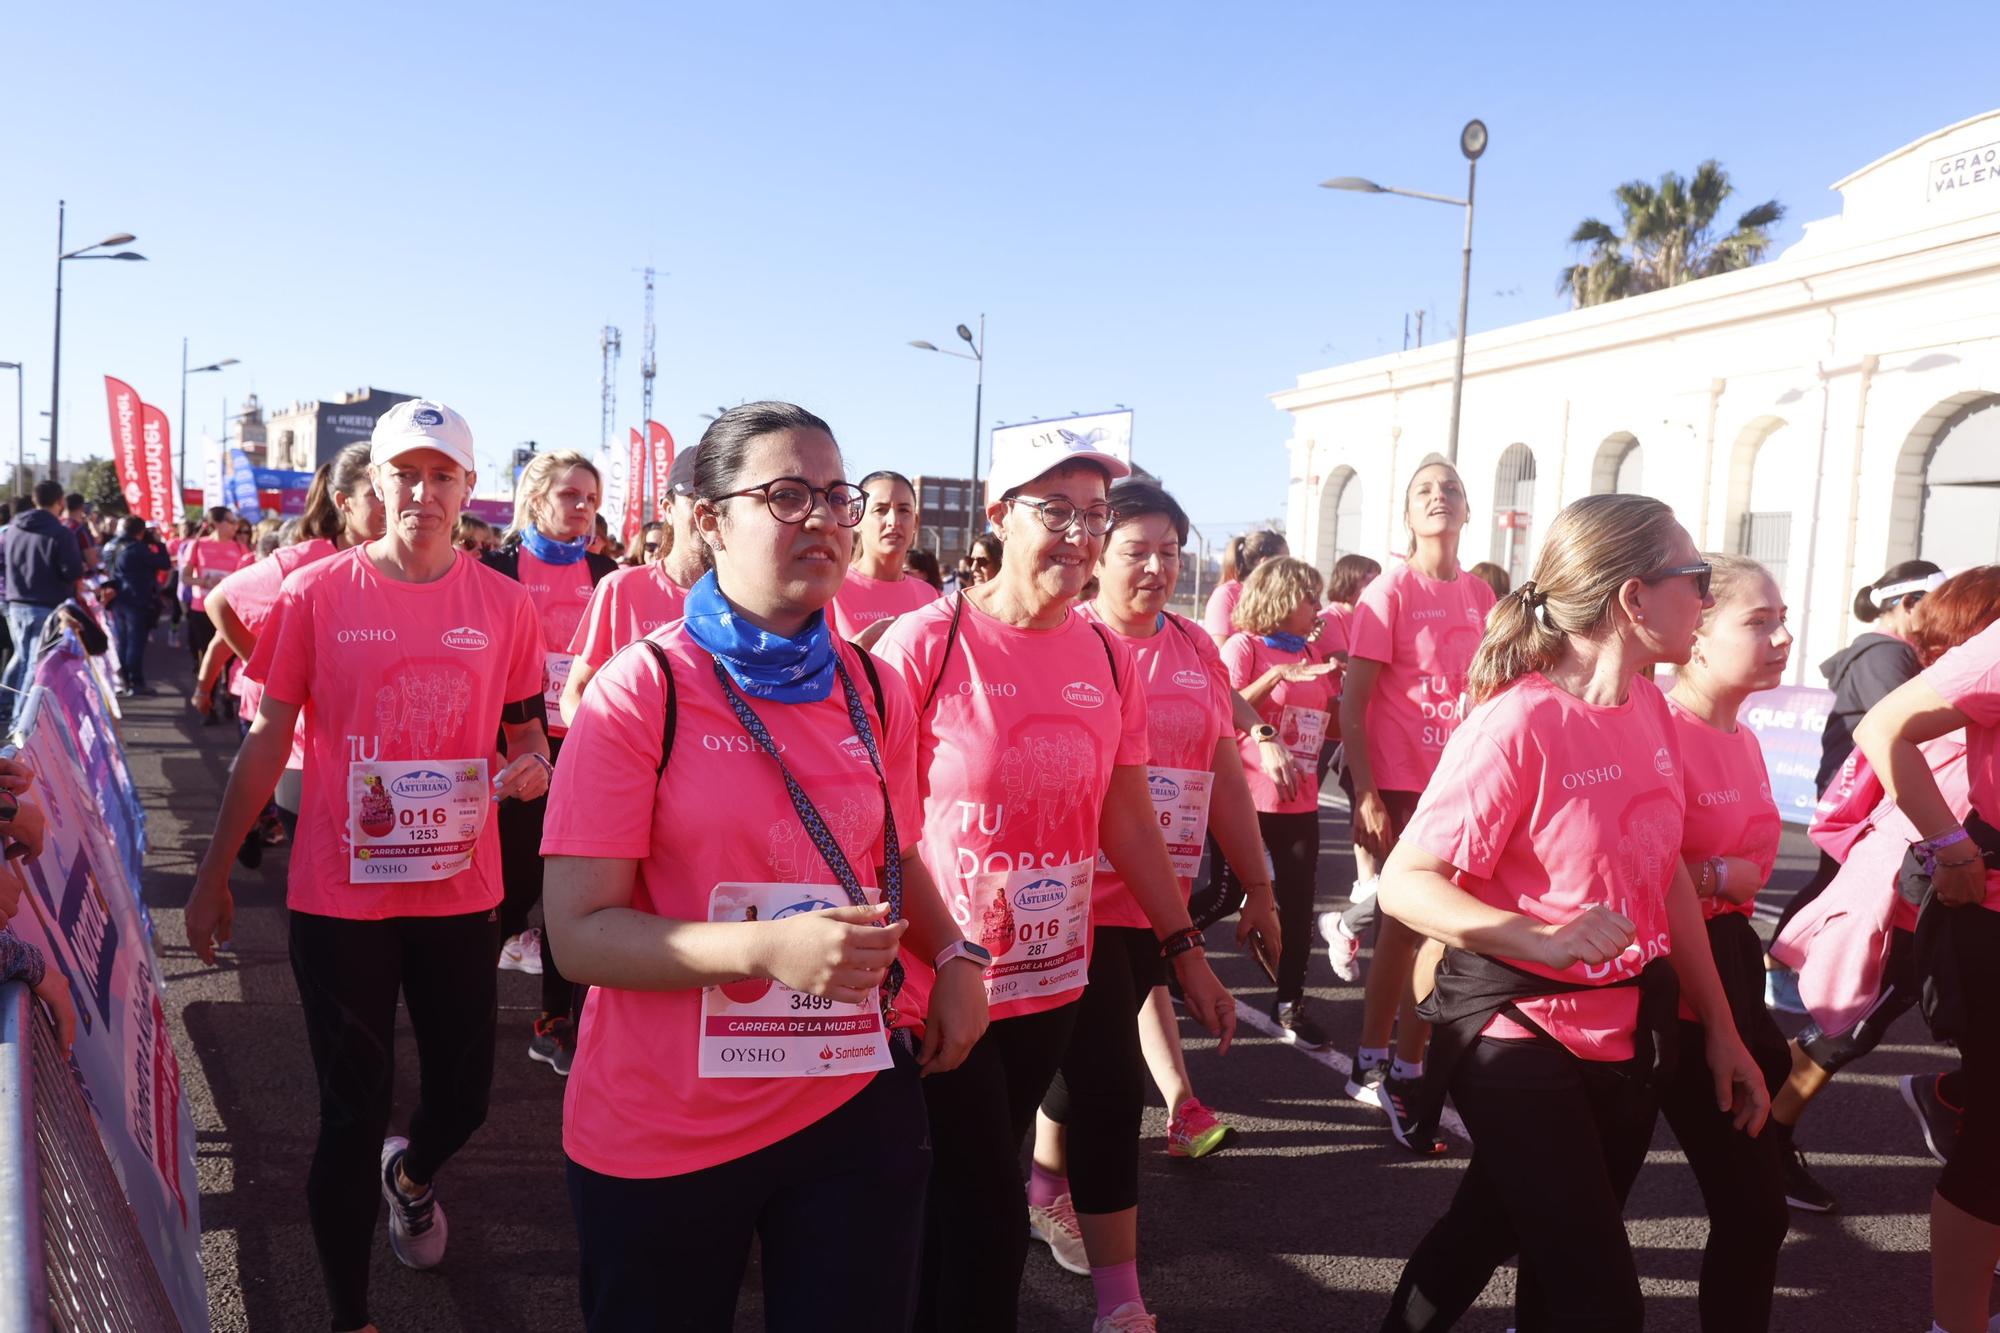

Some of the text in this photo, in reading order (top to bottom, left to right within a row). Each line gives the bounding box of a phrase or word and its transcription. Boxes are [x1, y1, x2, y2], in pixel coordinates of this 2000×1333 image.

[1940, 149, 1997, 175] GRAO
[337, 628, 397, 644] OYSHO
[445, 634, 486, 647] ASTURIANA
[958, 680, 1017, 697] OYSHO
[1419, 676, 1447, 695] TU
[1065, 689, 1102, 703] ASTURIANA
[1747, 707, 1797, 731] que
[1421, 726, 1449, 746] SU
[346, 735, 381, 761] TU
[1561, 763, 1623, 790] OYSHO
[396, 781, 449, 793] ASTURIANA
[1150, 787, 1176, 797] URIANA
[1697, 789, 1741, 808] OYSHO
[399, 807, 448, 826] 016
[955, 800, 1003, 836] TU
[409, 828, 439, 841] 1253
[408, 847, 420, 855] DE
[421, 846, 432, 854] LA
[433, 844, 459, 853] MUJER
[364, 863, 408, 875] OYSHO
[1018, 891, 1064, 905] ASTURIANA
[1018, 918, 1060, 942] 016
[1027, 943, 1048, 956] 287
[1048, 968, 1080, 985] Santander
[790, 994, 833, 1010] 3499
[728, 1019, 872, 1032] CARRERA DE LA MUJER 2023
[720, 1044, 876, 1063] OYSHO Santander
